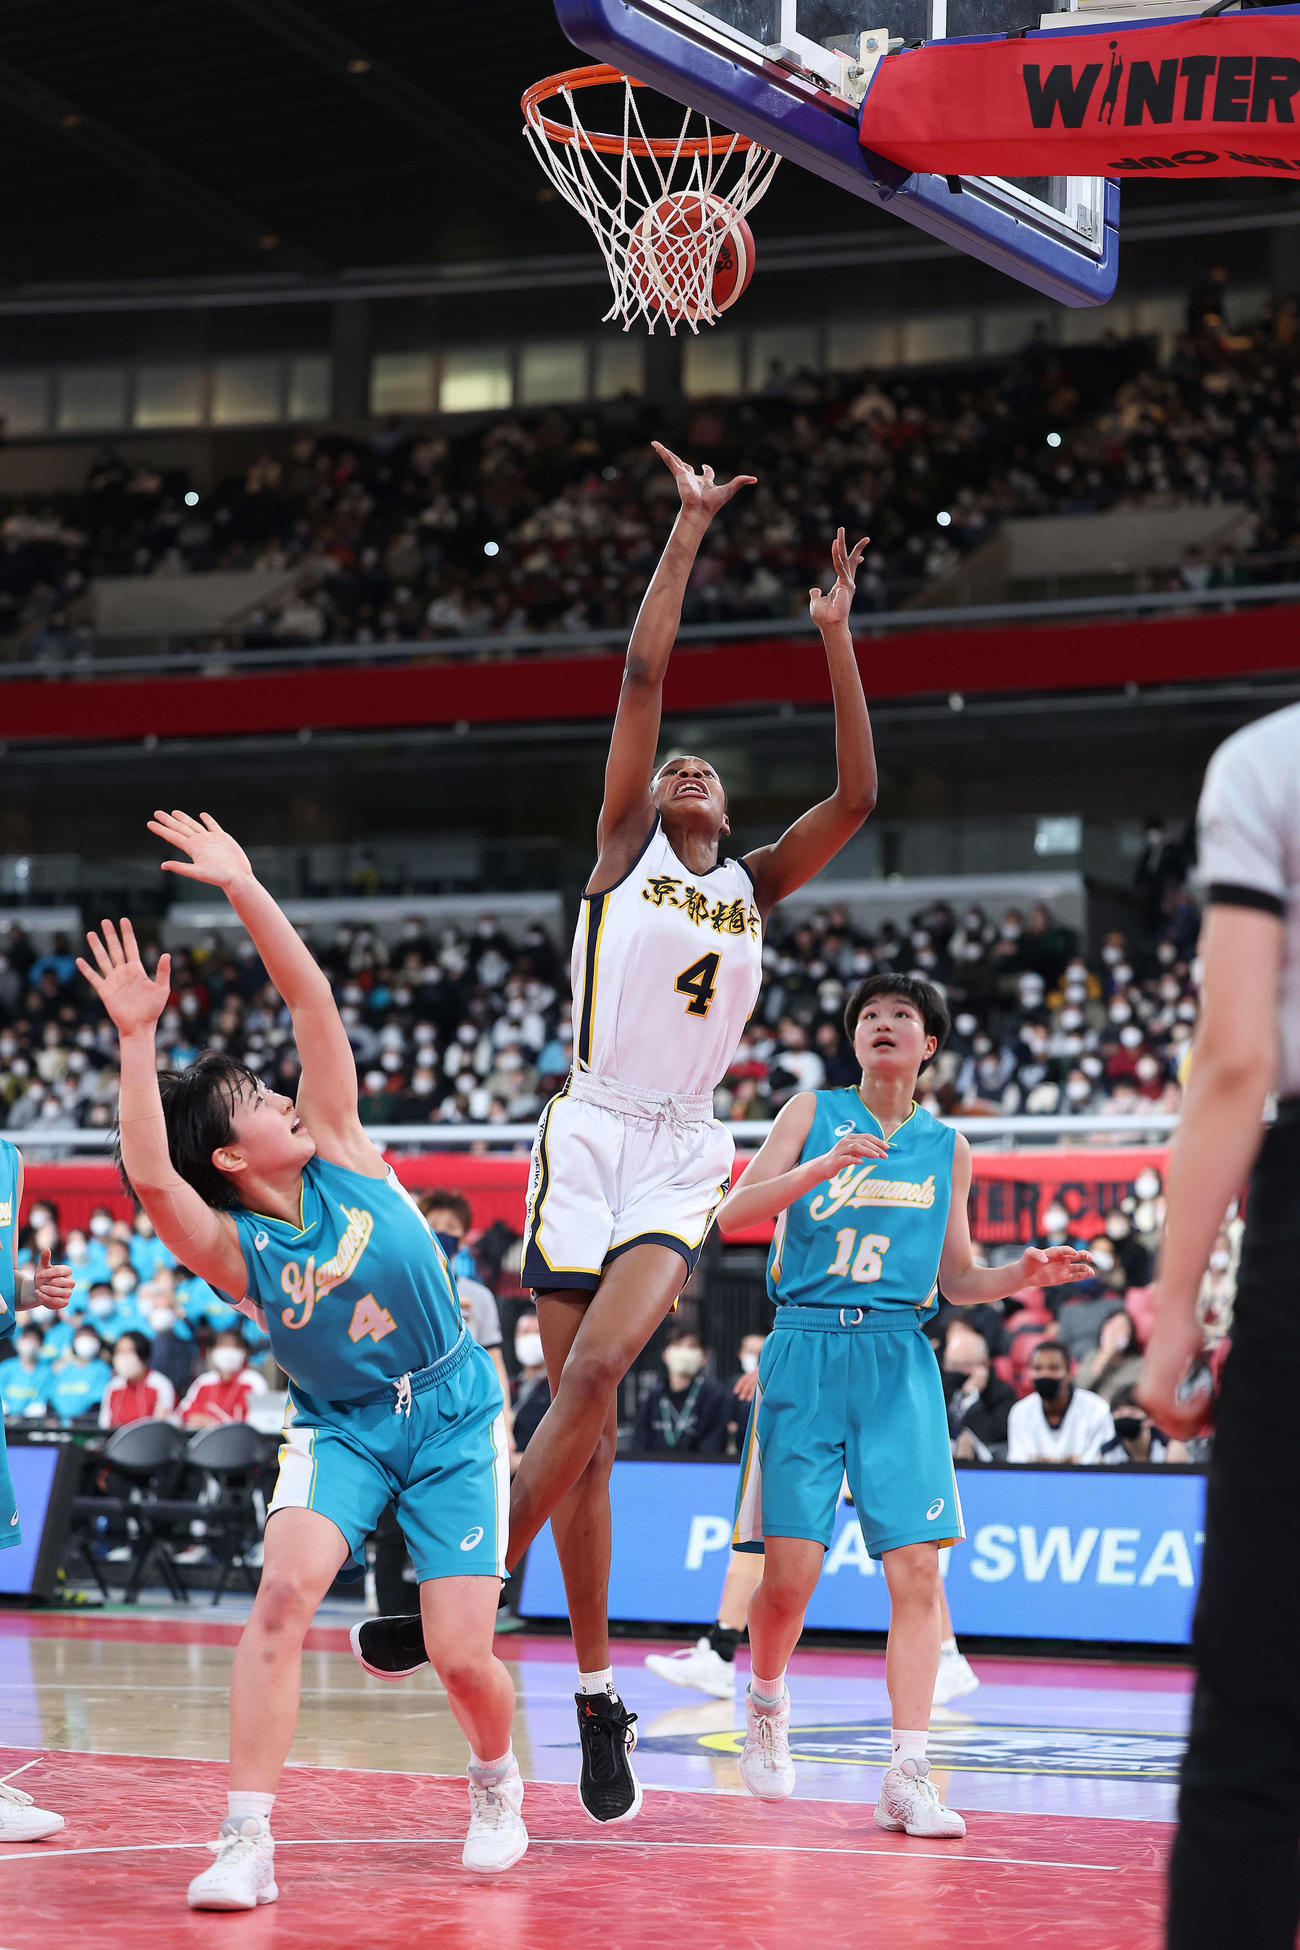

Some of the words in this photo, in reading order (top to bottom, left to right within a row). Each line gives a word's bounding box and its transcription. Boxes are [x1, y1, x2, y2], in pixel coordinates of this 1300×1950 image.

[1022, 41, 1300, 129] WINTER
[674, 950, 722, 1018] 4
[826, 1227, 891, 1283] 16
[347, 1292, 398, 1344] 4
[969, 1523, 1206, 1588] SWEA
